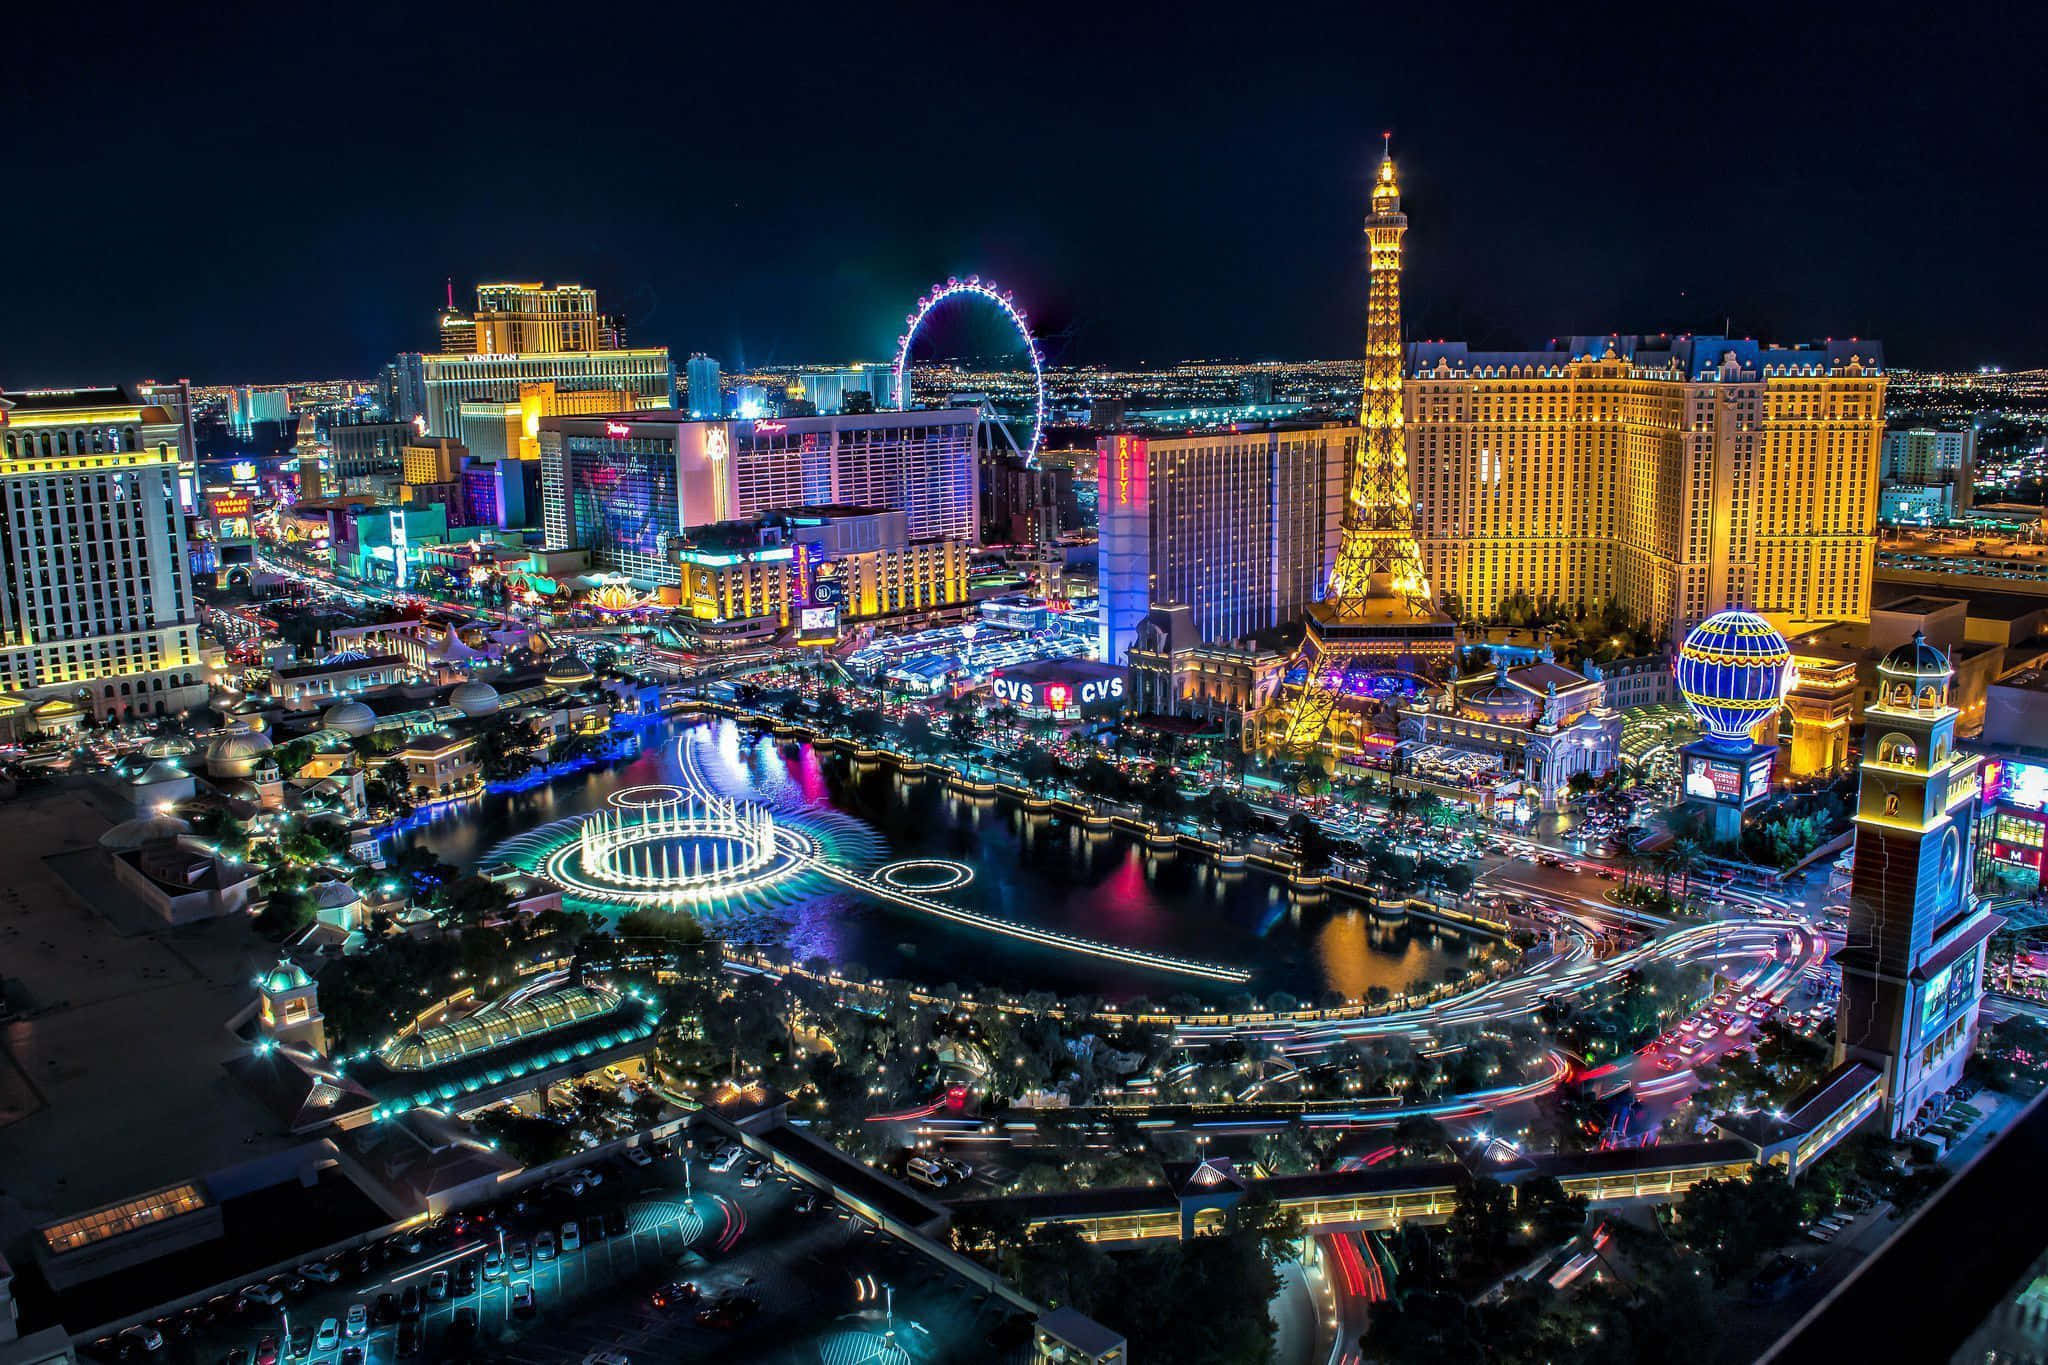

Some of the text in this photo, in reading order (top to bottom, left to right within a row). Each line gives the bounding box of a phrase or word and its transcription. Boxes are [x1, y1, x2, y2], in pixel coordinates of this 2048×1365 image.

[467, 354, 517, 362] VENETIAN
[215, 499, 248, 507] CAESARS
[217, 505, 247, 514] PALACE
[993, 678, 1034, 704] CVS
[1081, 677, 1123, 703] CVS
[1714, 771, 1738, 780] GORDON
[1714, 777, 1737, 785] RAMSAY
[2010, 850, 2022, 862] M
